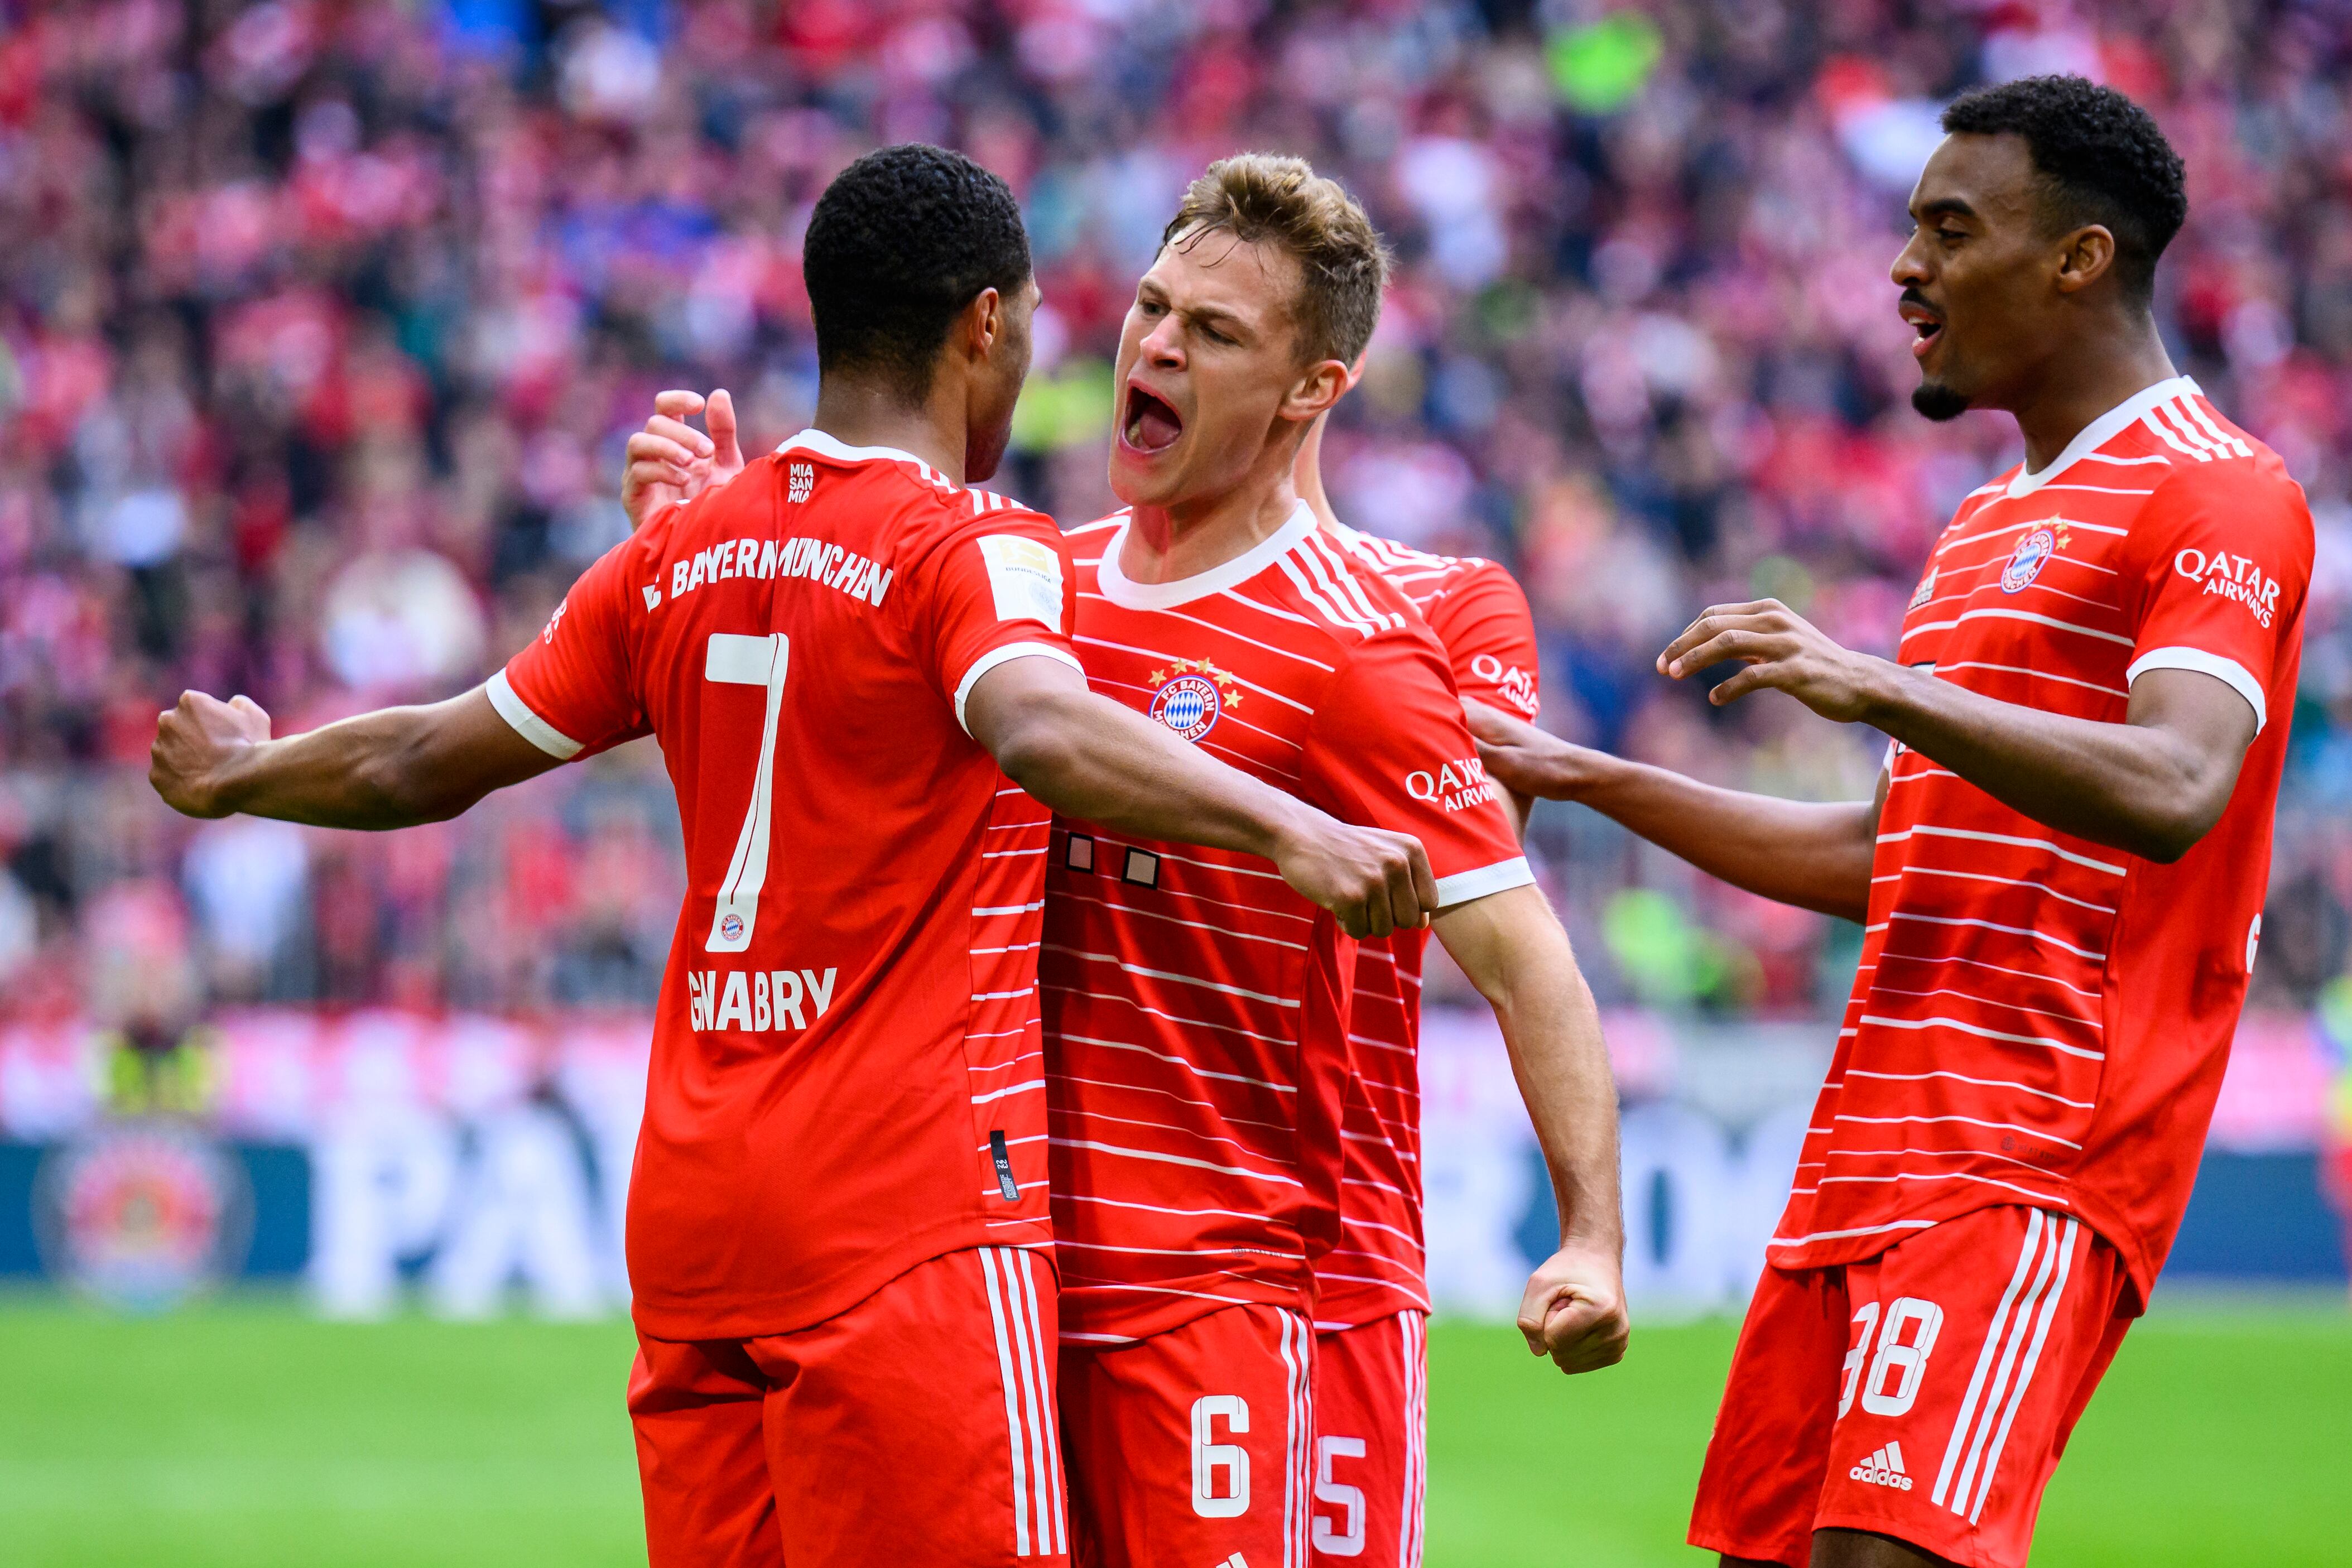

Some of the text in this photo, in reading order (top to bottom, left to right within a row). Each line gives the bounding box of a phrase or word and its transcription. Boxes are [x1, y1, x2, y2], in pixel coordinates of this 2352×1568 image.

[787, 490, 810, 503] MIA
[789, 477, 814, 490] SAN
[790, 463, 814, 477] MIA
[671, 538, 780, 599] BAYERN
[2175, 548, 2281, 612] QATAR
[2202, 578, 2273, 629] AIRWAYS
[1161, 680, 1215, 711] FC BAYERN
[705, 633, 789, 953] 7
[1405, 758, 1489, 803] QATAR
[689, 967, 838, 1032] GNABRY
[1837, 1296, 1944, 1421] 38
[1191, 1394, 1250, 1518] 6
[1849, 1465, 1913, 1492] adidas
[1311, 1435, 1366, 1557] 5
